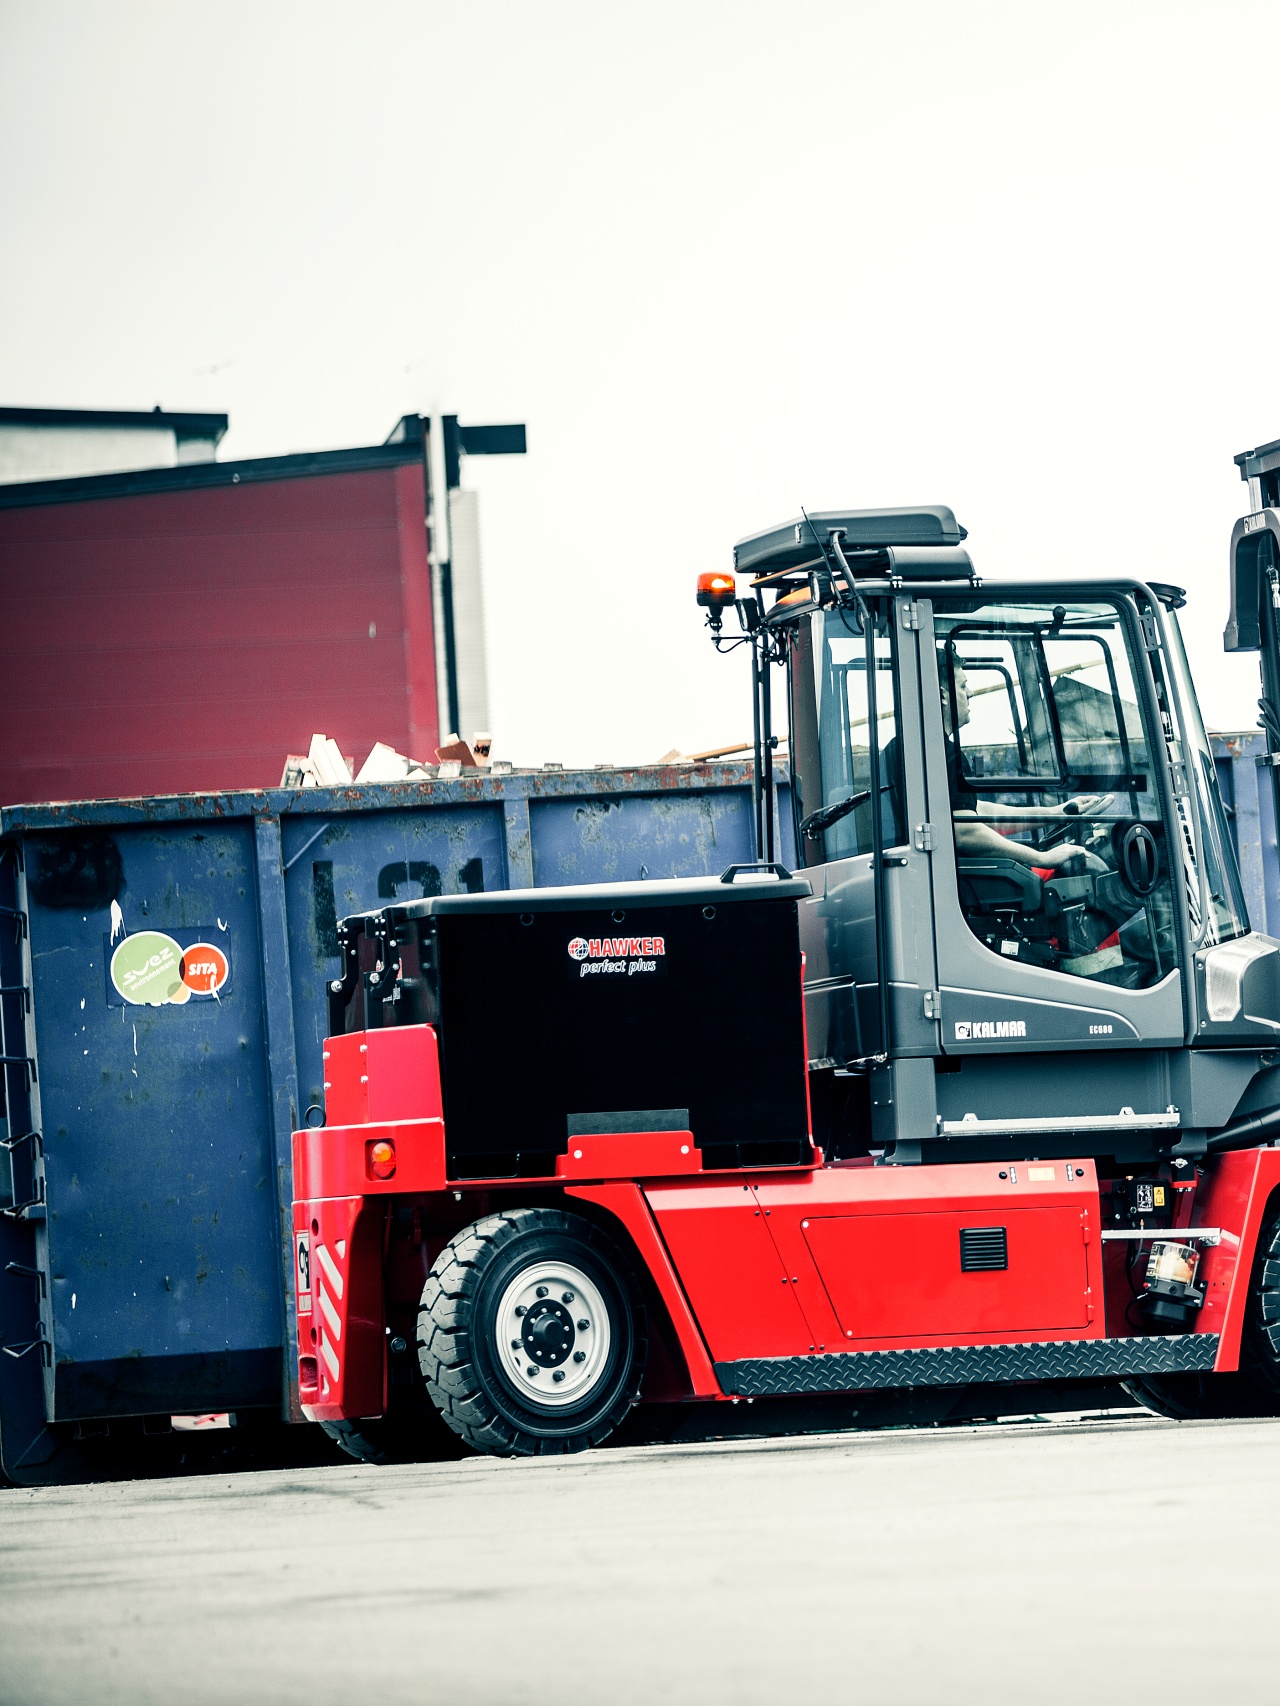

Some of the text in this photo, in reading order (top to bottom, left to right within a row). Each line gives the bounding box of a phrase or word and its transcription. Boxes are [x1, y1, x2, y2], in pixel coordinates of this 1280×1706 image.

[588, 937, 666, 958] HAWKER
[130, 958, 177, 992] environnement
[188, 962, 218, 976] SITA
[580, 958, 657, 977] perfect plus
[972, 1021, 1027, 1039] KALMAR
